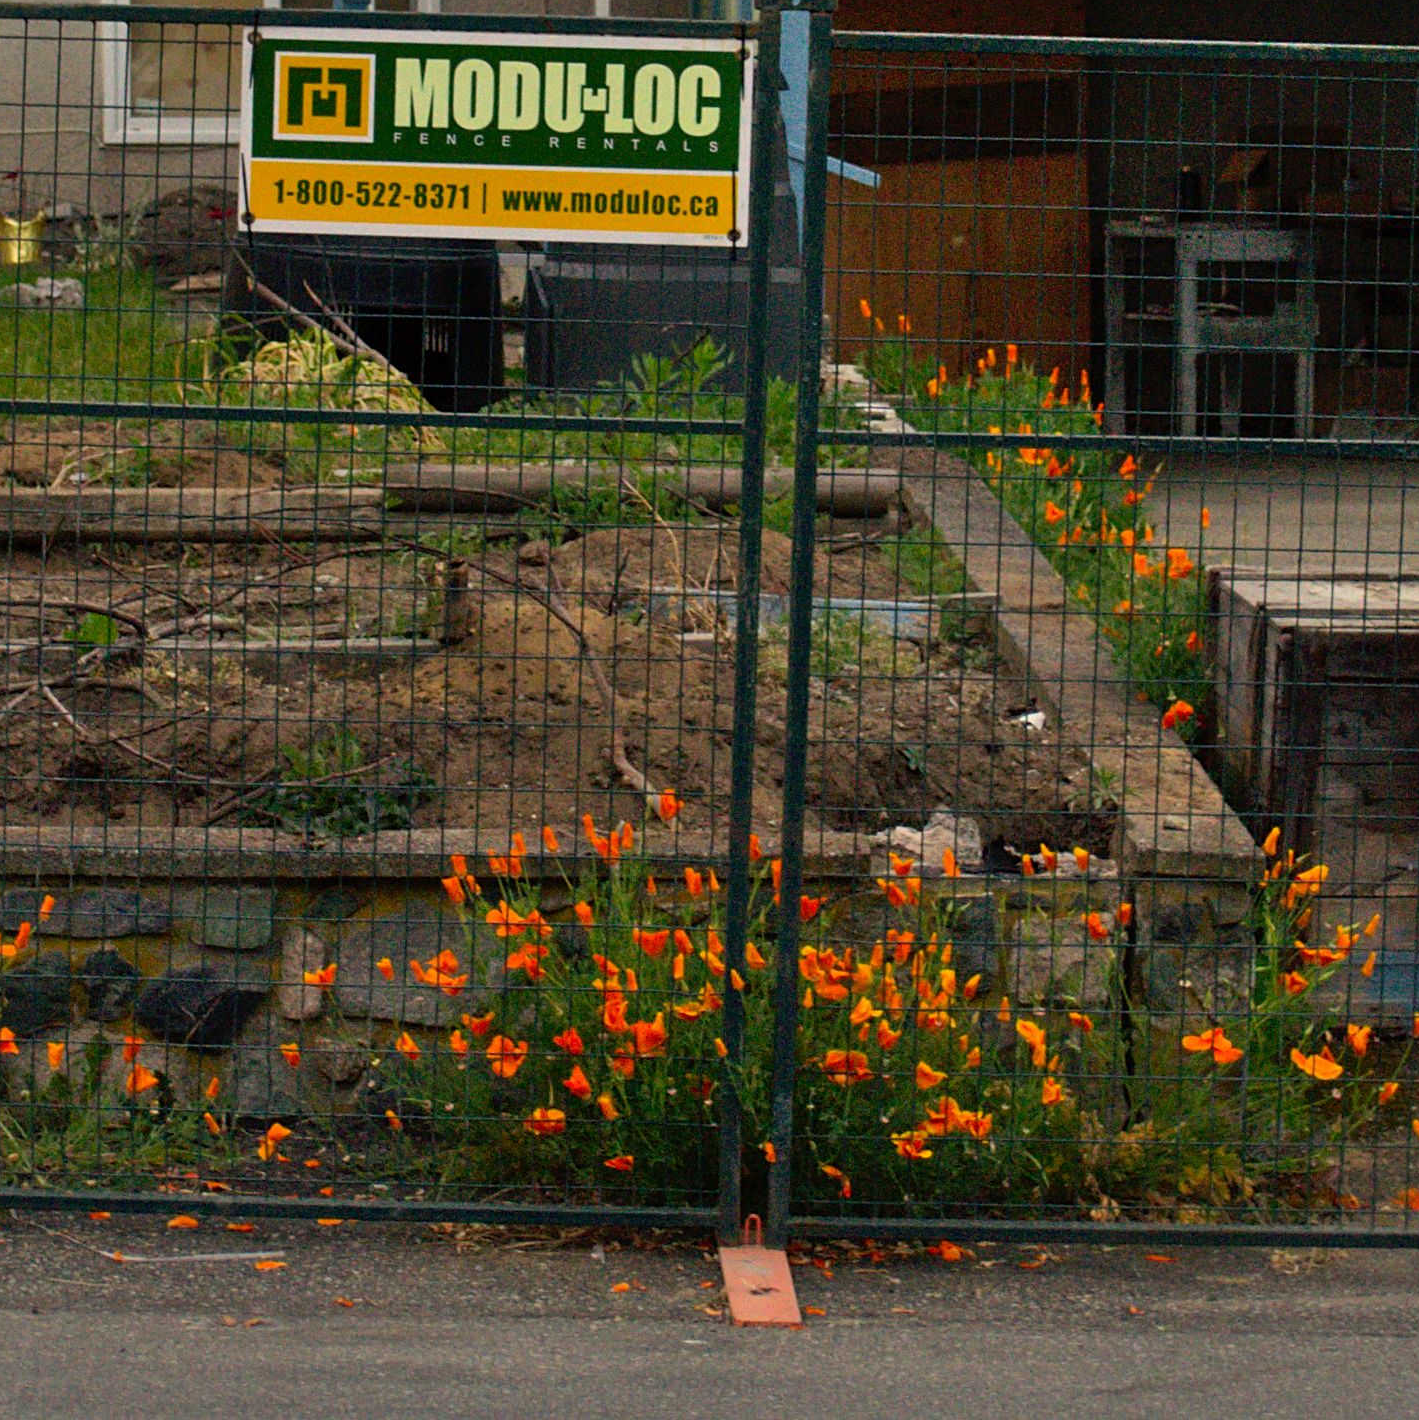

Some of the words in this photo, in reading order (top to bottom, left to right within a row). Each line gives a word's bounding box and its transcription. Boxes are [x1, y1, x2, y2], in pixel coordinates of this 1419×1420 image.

[393, 131, 511, 147] FENCE
[548, 136, 720, 153] RENTALS
[273, 179, 471, 210] 1-800-522-8371
[502, 189, 719, 217] www.moduloc.ca
